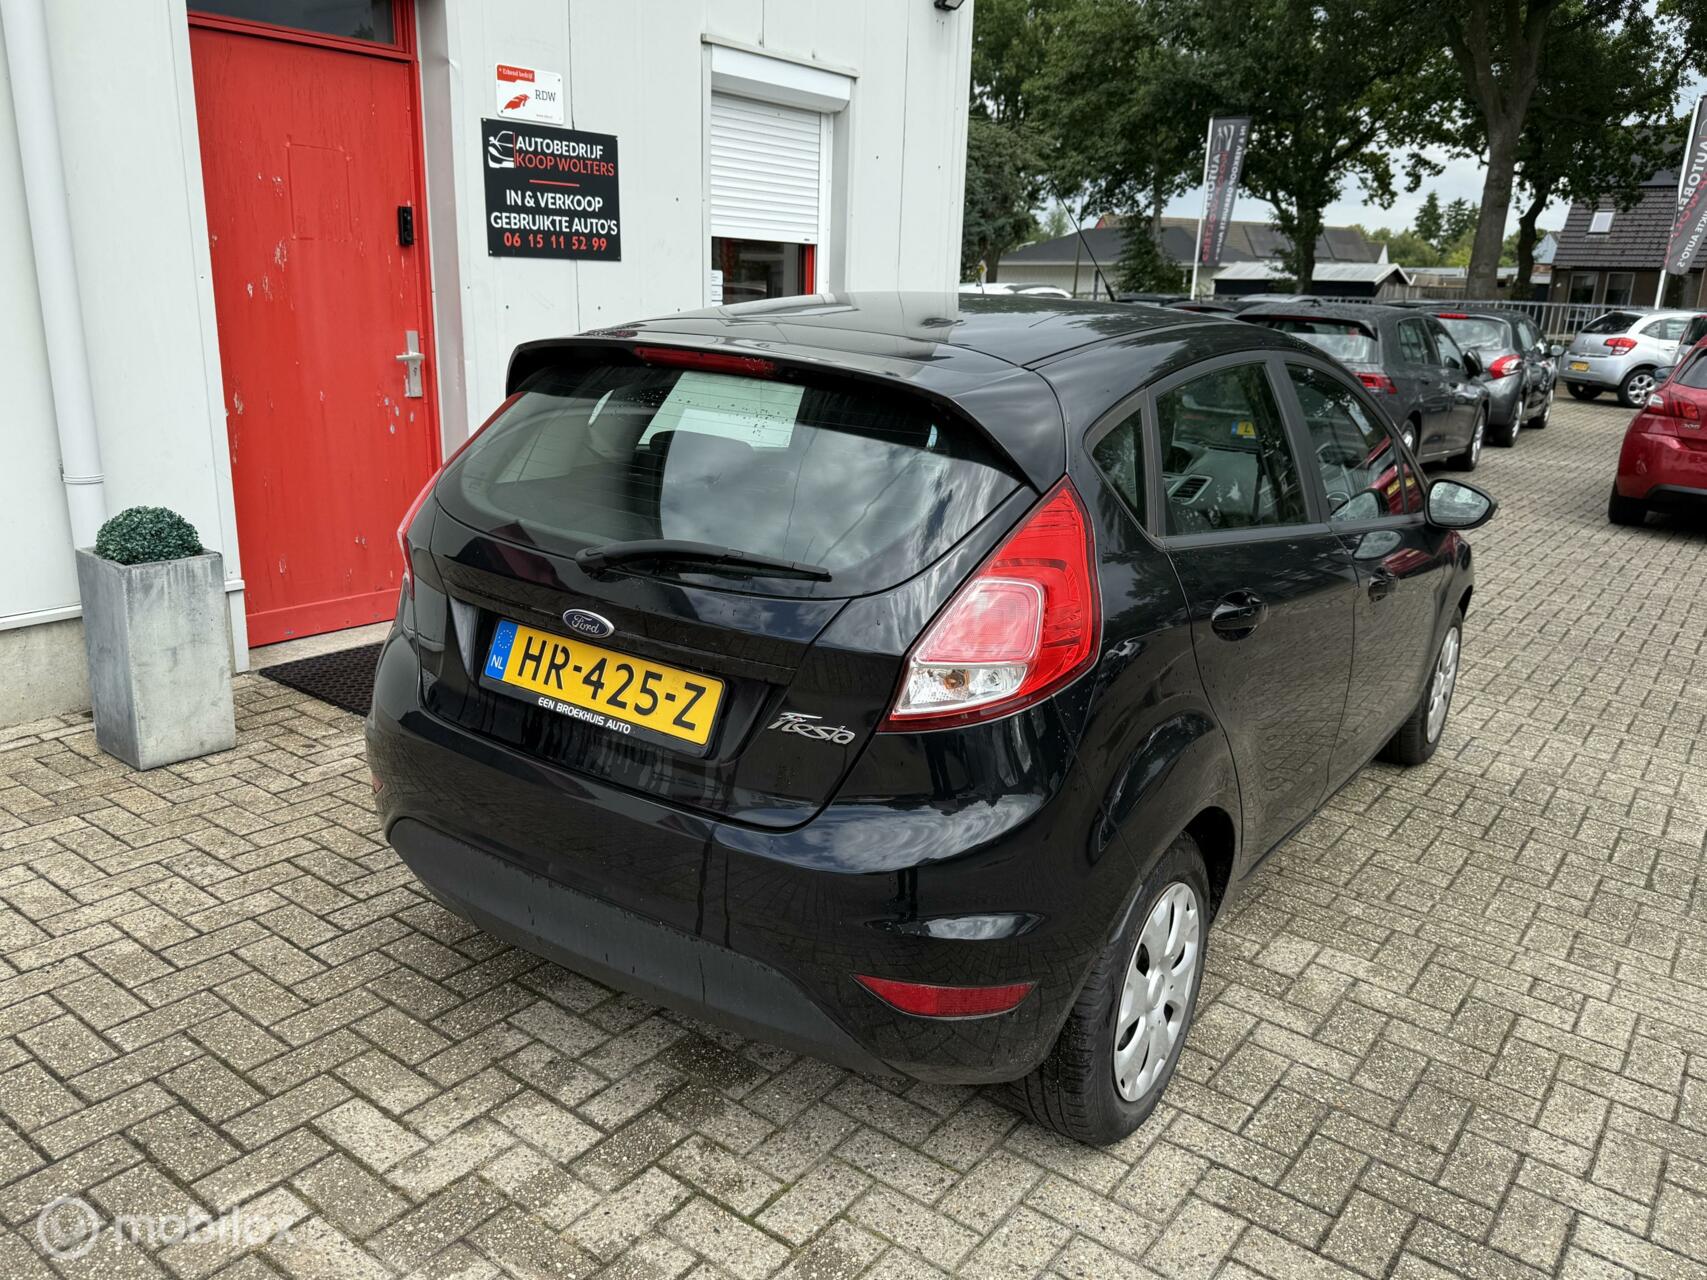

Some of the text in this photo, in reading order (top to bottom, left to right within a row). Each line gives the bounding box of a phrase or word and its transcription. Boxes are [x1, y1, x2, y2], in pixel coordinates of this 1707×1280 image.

[535, 89, 557, 102] RDW
[516, 136, 604, 159] AUTOBEDRIJF
[516, 153, 615, 176] KOOP WOLTERS
[506, 189, 604, 213] IN & VERKOOP
[490, 212, 618, 235] GEBRUIKTE AUTO'S
[504, 232, 607, 251] 06 15 11 52 99
[571, 614, 600, 634] Ford
[490, 636, 707, 731] NL HR-425-Z
[538, 697, 631, 735] EEN BROEKHUIS AUTO
[768, 712, 856, 745] Fiesta
